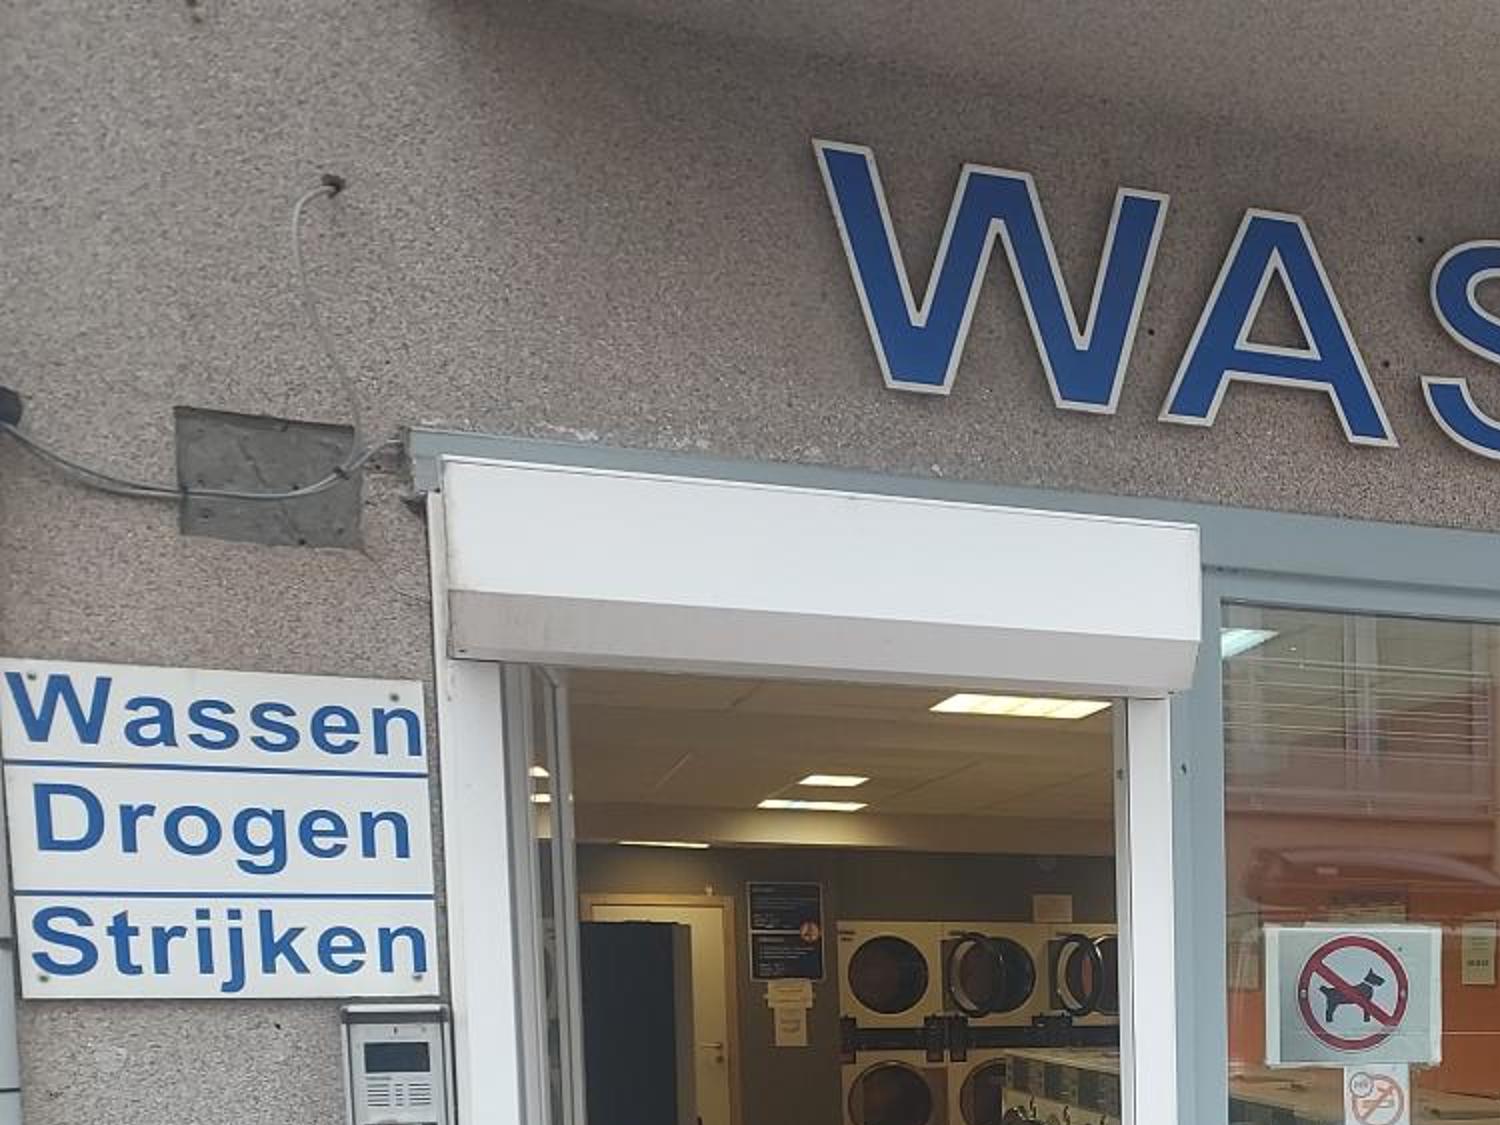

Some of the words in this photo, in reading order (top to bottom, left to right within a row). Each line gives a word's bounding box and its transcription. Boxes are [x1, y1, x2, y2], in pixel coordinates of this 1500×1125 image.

[4, 671, 422, 757] Wassen
[32, 783, 411, 875] Drogen
[31, 906, 428, 993] Strijken
